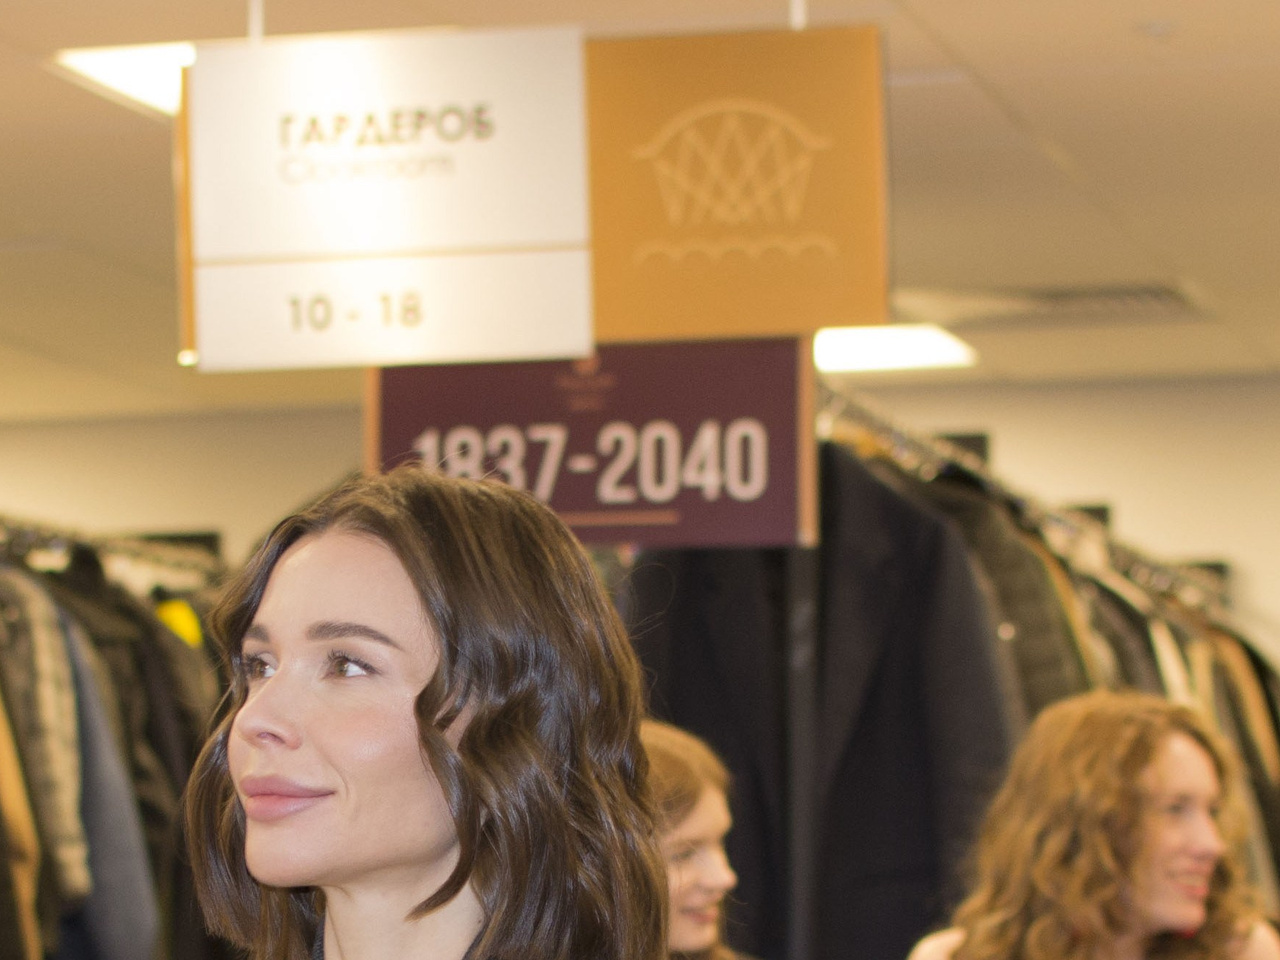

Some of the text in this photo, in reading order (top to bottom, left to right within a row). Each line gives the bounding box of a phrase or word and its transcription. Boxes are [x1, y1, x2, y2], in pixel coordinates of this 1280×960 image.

[279, 104, 495, 148] ГАРДЕРОБ
[287, 296, 332, 330] 10
[379, 293, 422, 328] 18
